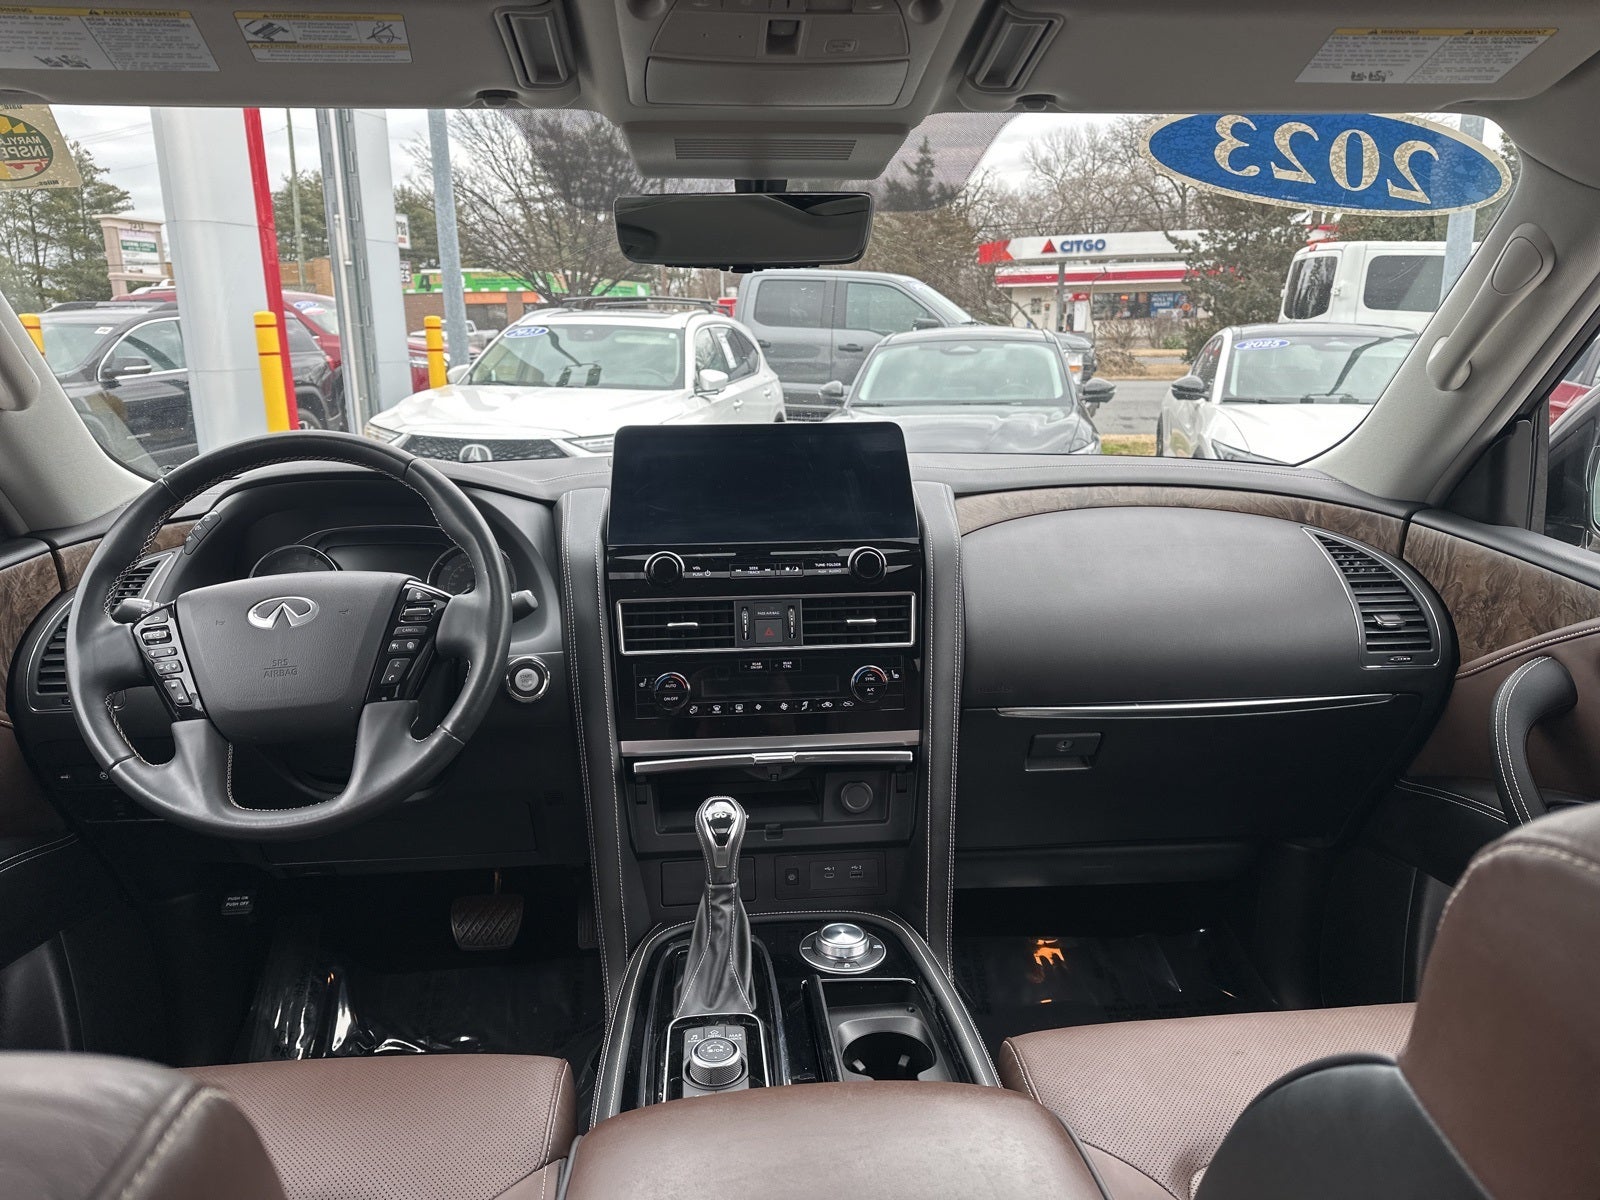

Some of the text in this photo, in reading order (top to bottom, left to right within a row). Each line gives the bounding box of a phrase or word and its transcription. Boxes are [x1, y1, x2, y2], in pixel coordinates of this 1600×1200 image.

[1060, 238, 1106, 253] CITGO
[271, 658, 288, 667] SRS
[263, 667, 298, 678] AIRBAG
